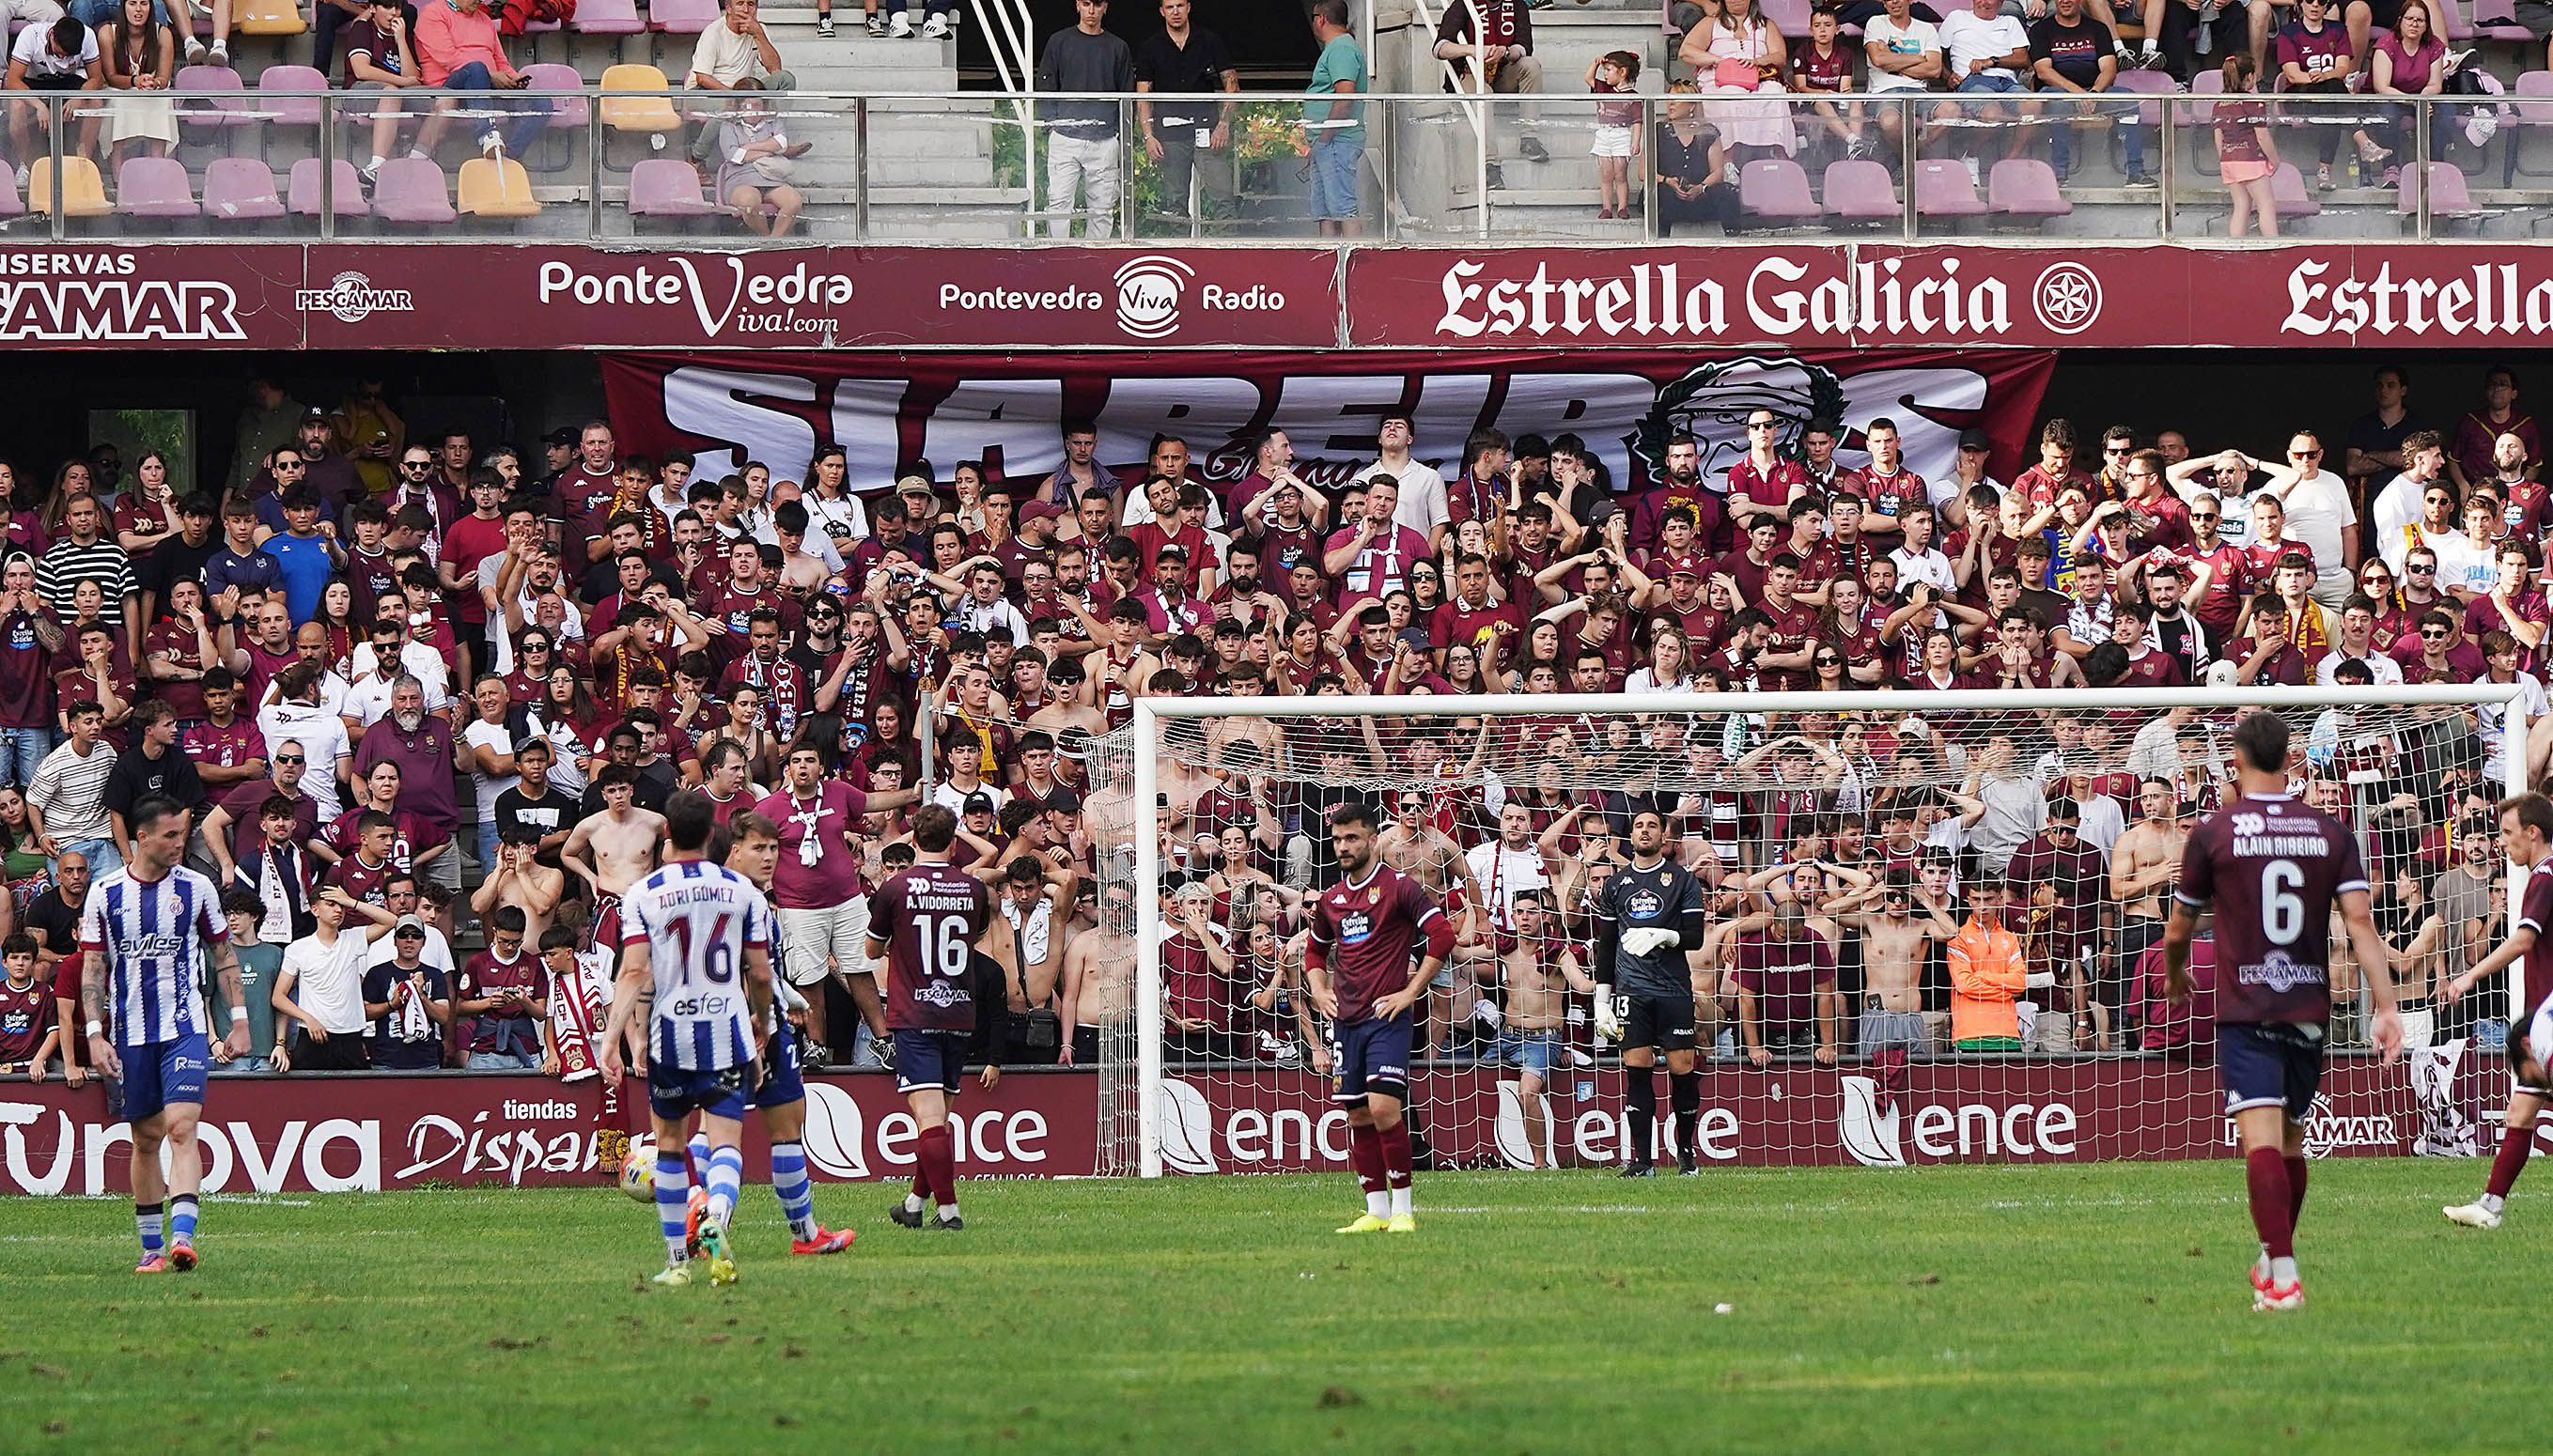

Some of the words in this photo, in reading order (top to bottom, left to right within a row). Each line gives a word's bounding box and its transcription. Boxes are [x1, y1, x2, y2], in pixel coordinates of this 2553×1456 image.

[1501, 0, 1515, 36] ELO
[0, 281, 248, 339] AMAR
[295, 289, 414, 311] PESCAMAR
[940, 284, 1103, 311] Pontevedra
[1123, 284, 1175, 316] Viva
[1201, 284, 1285, 311] Radio
[1436, 259, 1731, 338] Estrella
[1745, 256, 2014, 337] Galicia
[2233, 837, 2273, 857] ALAIN
[2274, 837, 2329, 858] RIBEIRO
[659, 890, 690, 909] ADRI
[1631, 904, 1656, 912] Galicia
[2261, 859, 2305, 946] 6
[1342, 916, 1369, 928] Estrella
[1343, 925, 1368, 937] Galicia
[664, 911, 734, 986] 16
[911, 914, 969, 977] 16
[674, 992, 733, 1016] esfer
[504, 1099, 577, 1121] tiendas
[1225, 1108, 1350, 1161] enc
[1914, 1102, 2078, 1157] ence
[2224, 1116, 2398, 1147] PAMAR
